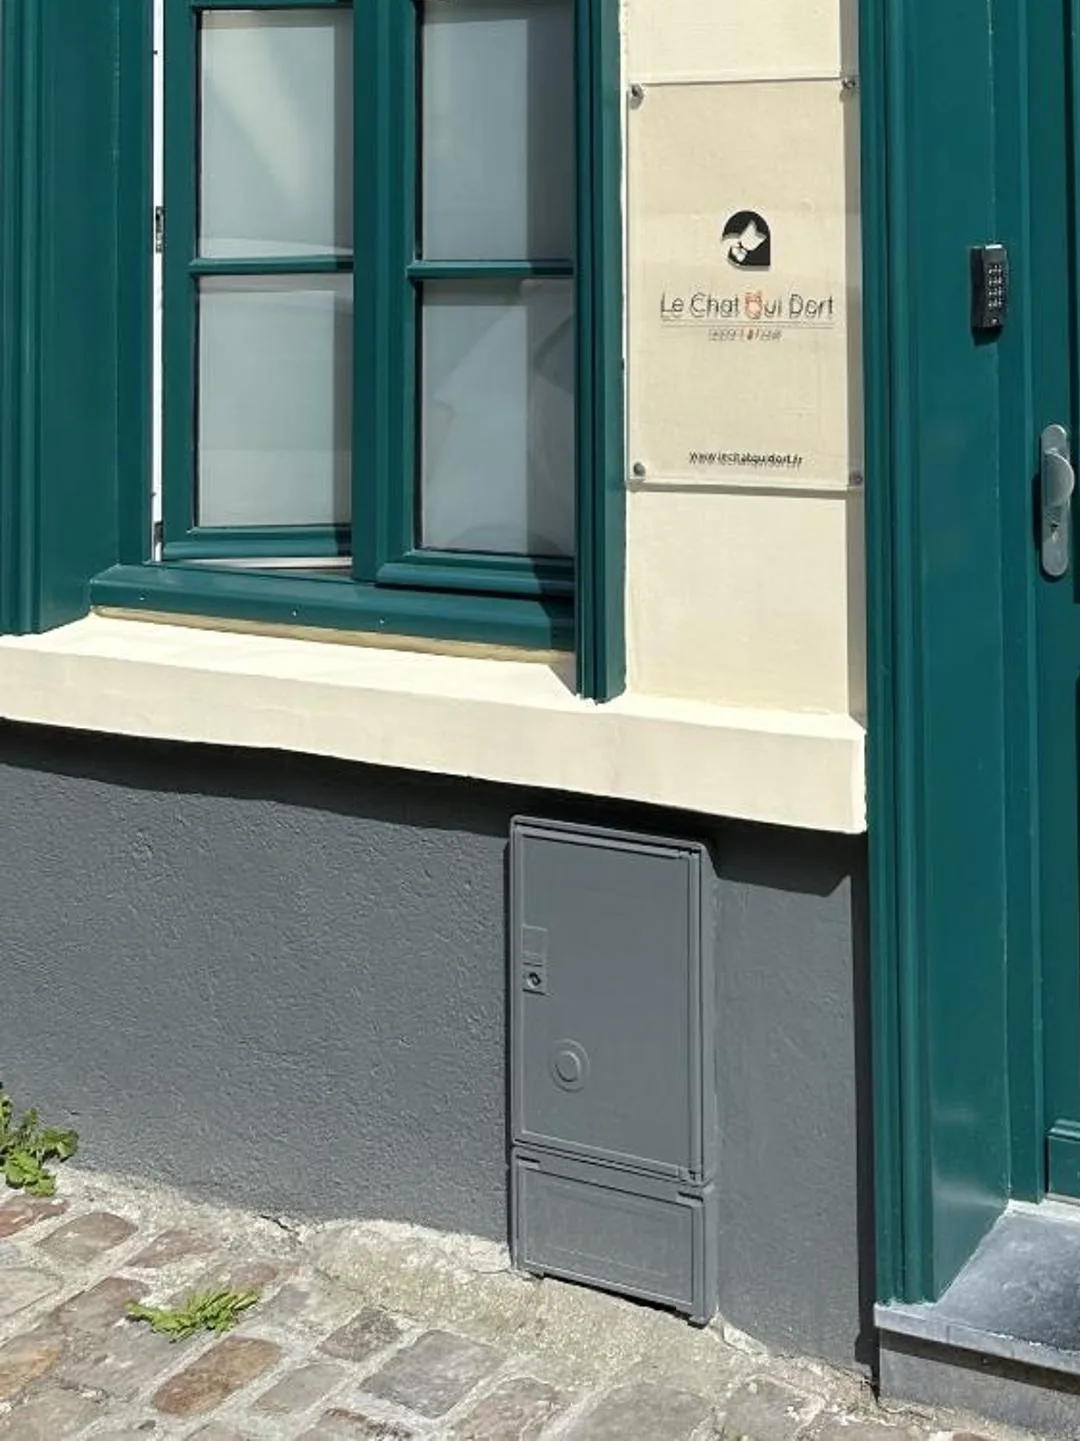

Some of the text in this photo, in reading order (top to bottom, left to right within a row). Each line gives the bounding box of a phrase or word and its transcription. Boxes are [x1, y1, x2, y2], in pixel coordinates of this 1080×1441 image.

[660, 292, 684, 315] Le
[690, 292, 740, 316] Chat
[789, 293, 834, 317] Dort
